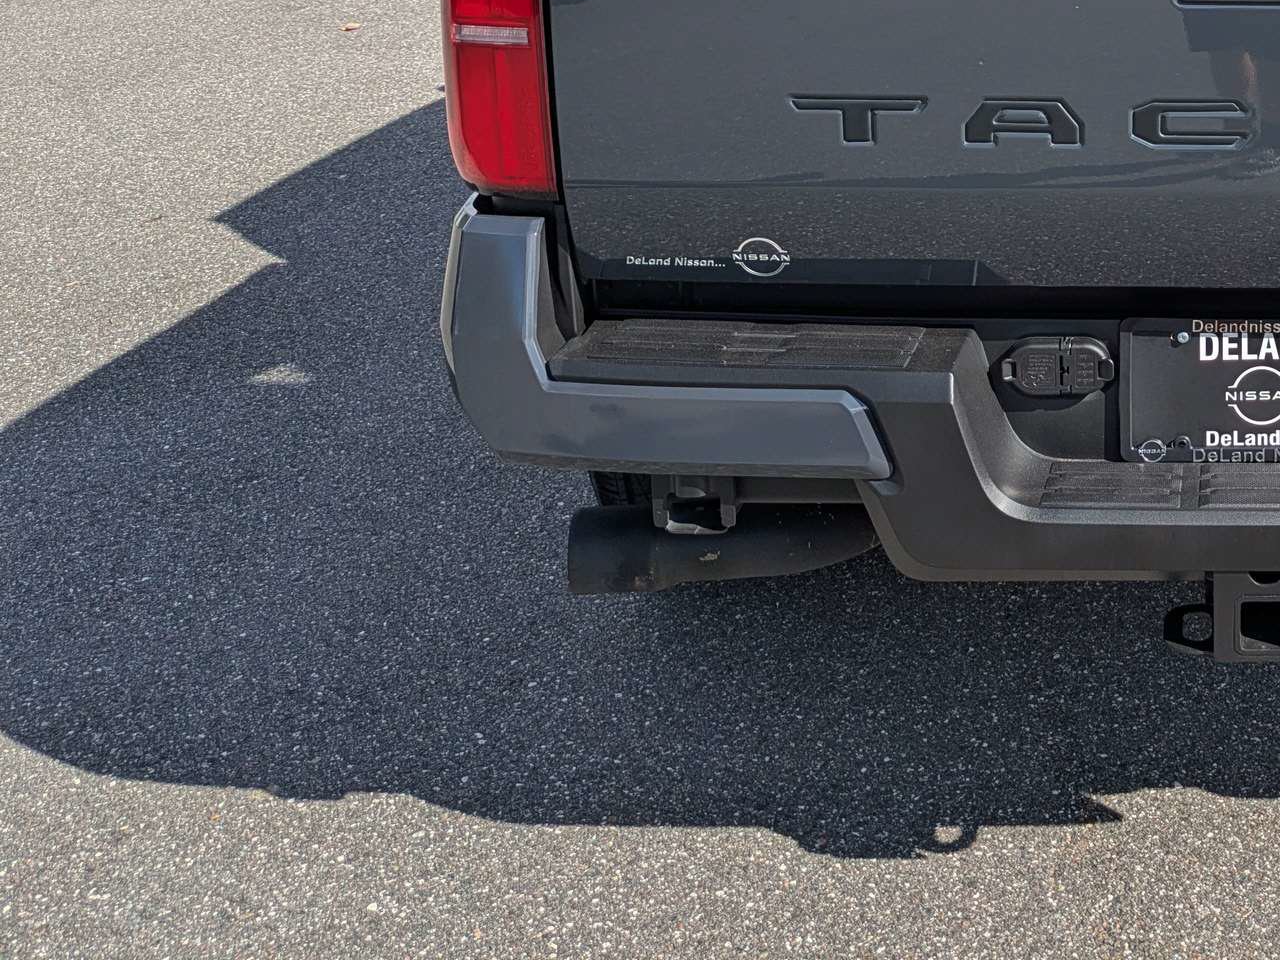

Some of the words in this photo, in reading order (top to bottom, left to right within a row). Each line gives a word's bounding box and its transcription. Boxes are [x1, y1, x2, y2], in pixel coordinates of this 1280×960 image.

[626, 255, 671, 266] DeLand
[732, 253, 791, 262] NISSAN
[1192, 448, 1276, 463] DeLand
